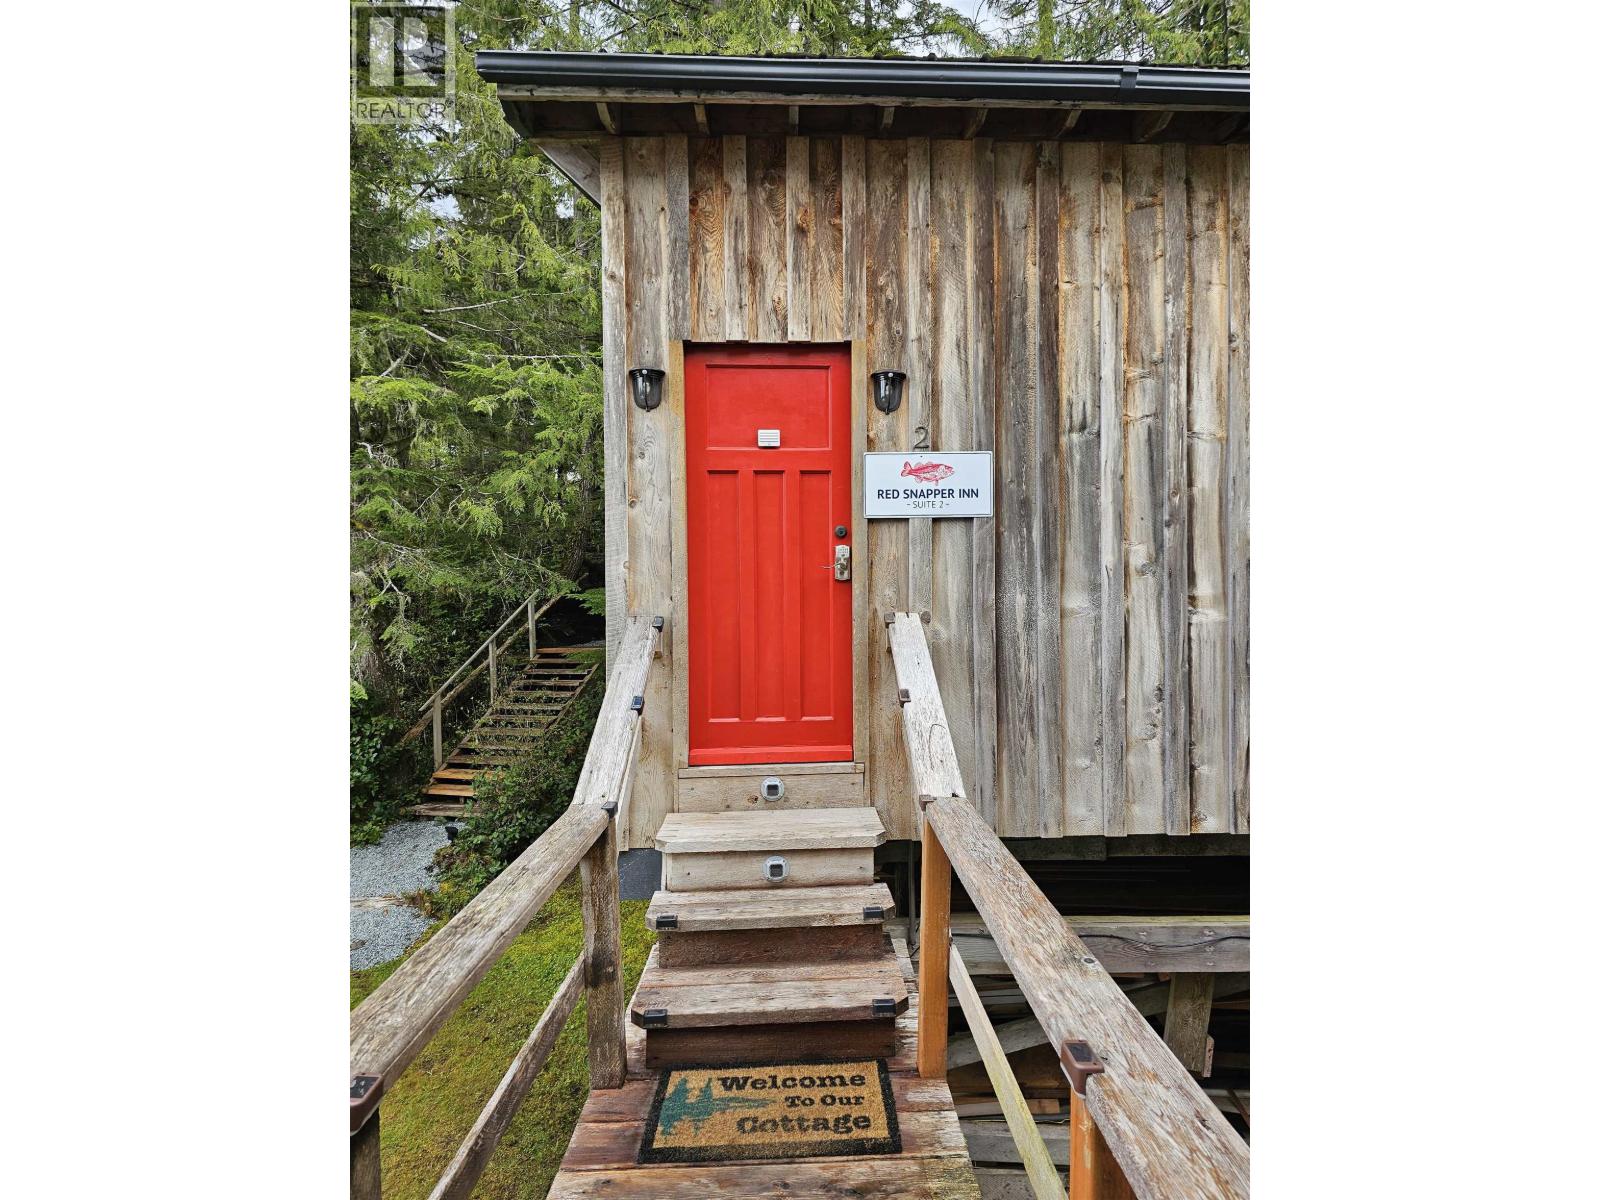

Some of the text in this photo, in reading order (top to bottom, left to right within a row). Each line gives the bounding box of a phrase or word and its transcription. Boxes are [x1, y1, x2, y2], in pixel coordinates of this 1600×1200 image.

[914, 426, 930, 449] 2
[877, 488, 979, 500] RED SNAPPER INN
[912, 501, 936, 509] SUITE
[939, 501, 944, 509] 2
[718, 1074, 866, 1091] Welcome
[784, 1094, 865, 1108] To Our
[737, 1115, 871, 1134] Cottage
